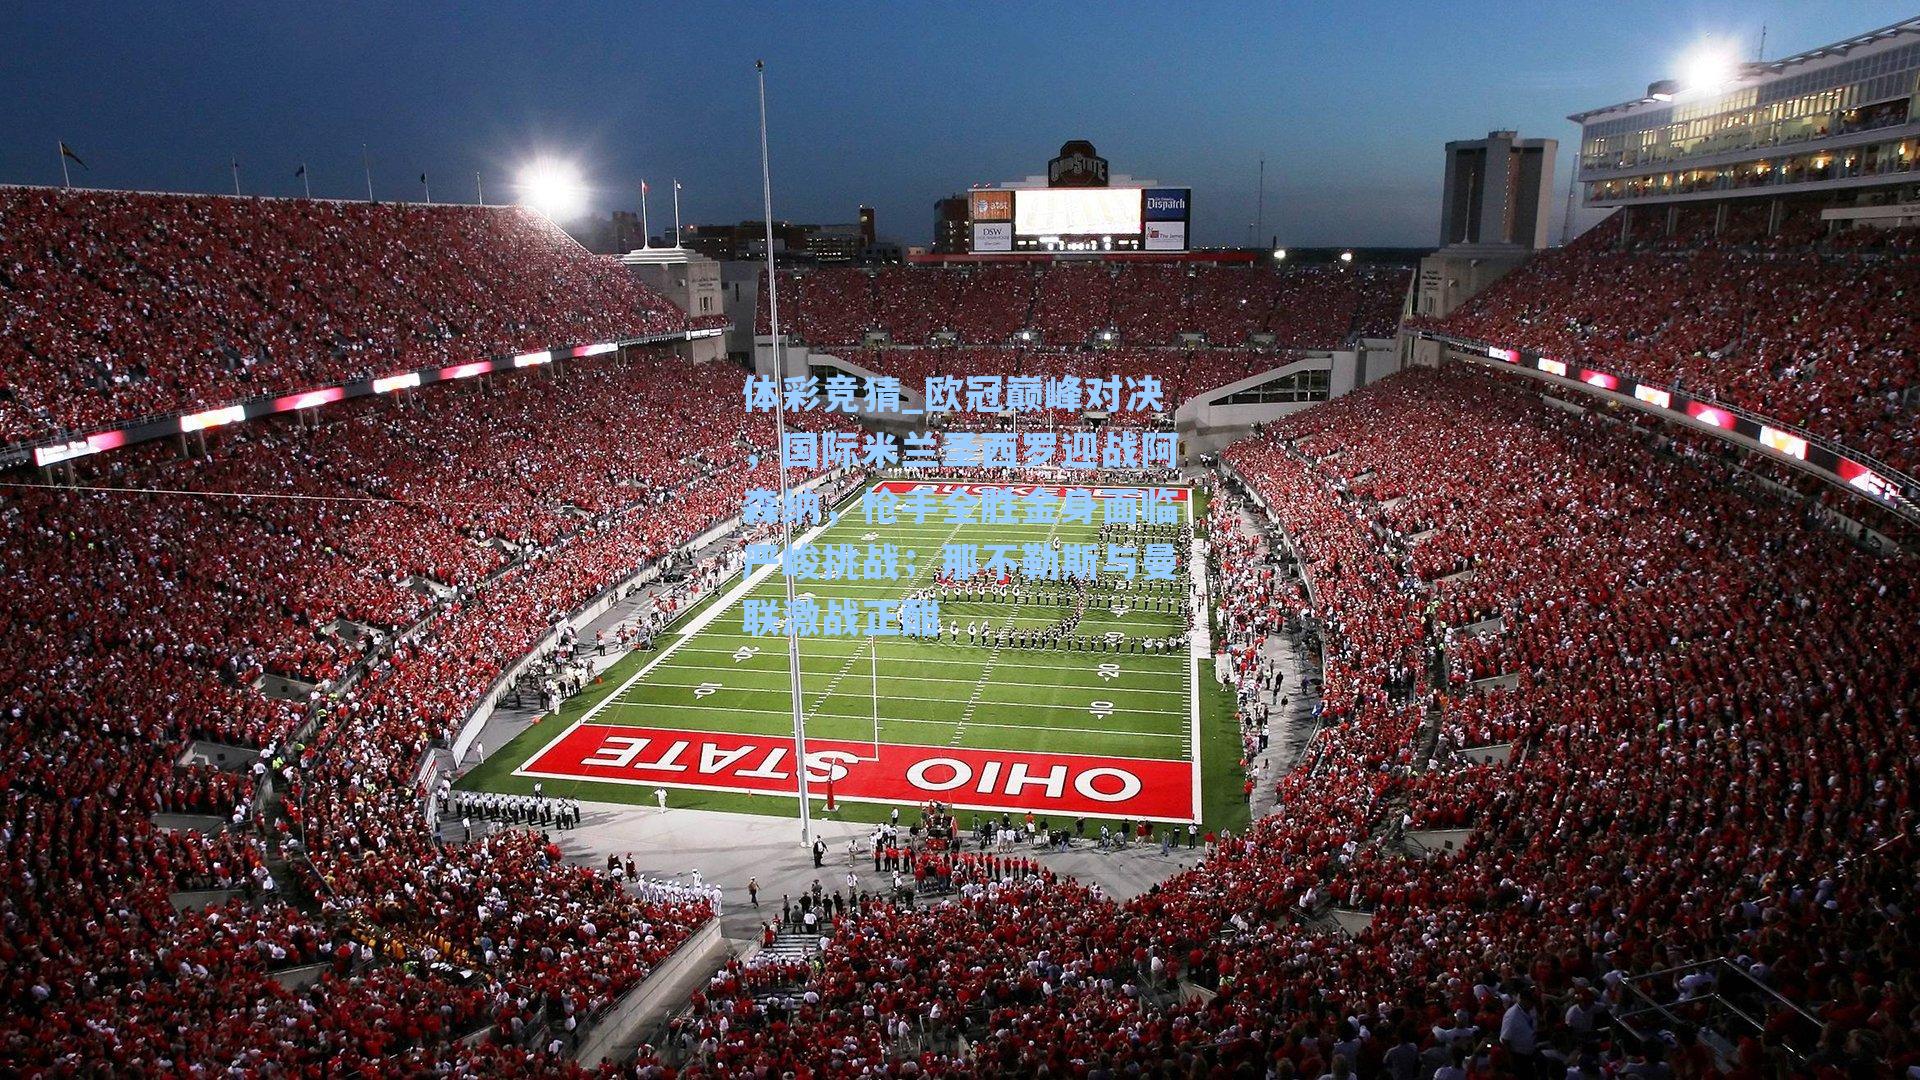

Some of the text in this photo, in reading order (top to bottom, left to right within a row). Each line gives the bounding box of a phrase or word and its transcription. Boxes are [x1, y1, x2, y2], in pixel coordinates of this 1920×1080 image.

[1147, 197, 1186, 211] Dispatch
[983, 228, 1002, 236] DSW
[1096, 663, 1120, 678] 20
[1089, 701, 1114, 715] 10
[580, 735, 1143, 802] OHIO STATE
